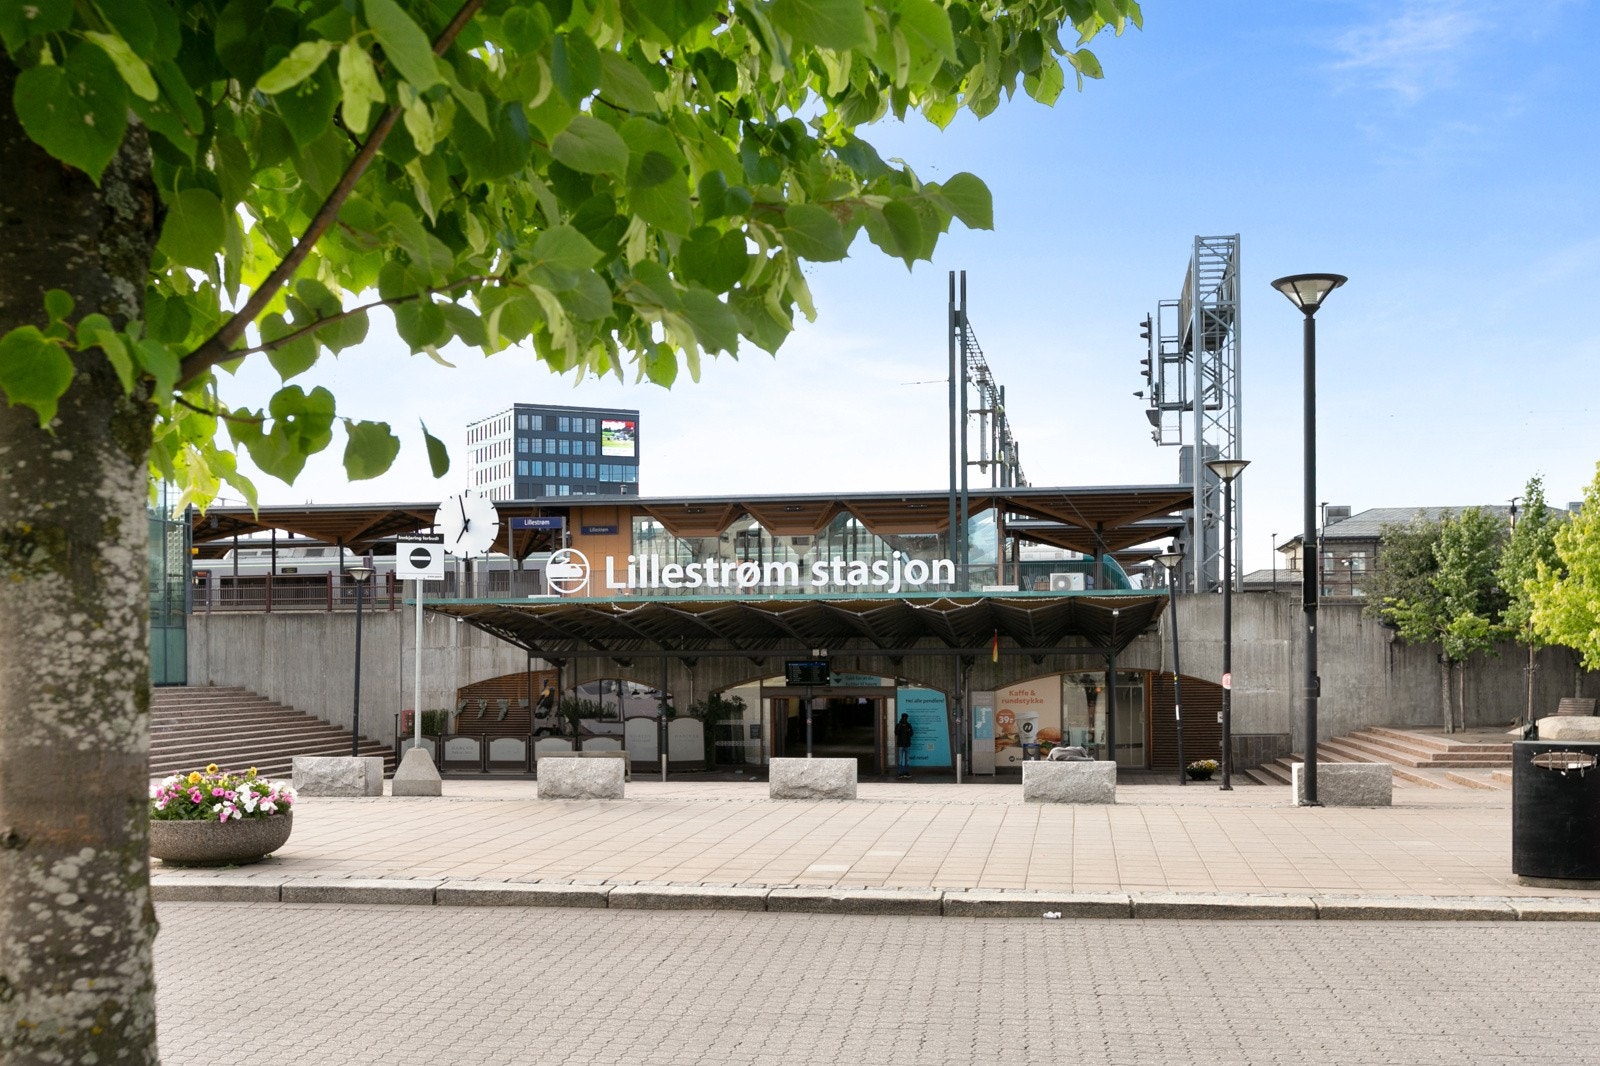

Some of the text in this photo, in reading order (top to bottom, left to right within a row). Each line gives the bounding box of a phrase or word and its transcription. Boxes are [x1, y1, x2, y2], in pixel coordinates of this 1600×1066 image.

[605, 550, 955, 594] Lillestrøm stasjon
[1001, 697, 1044, 705] rundstykke
